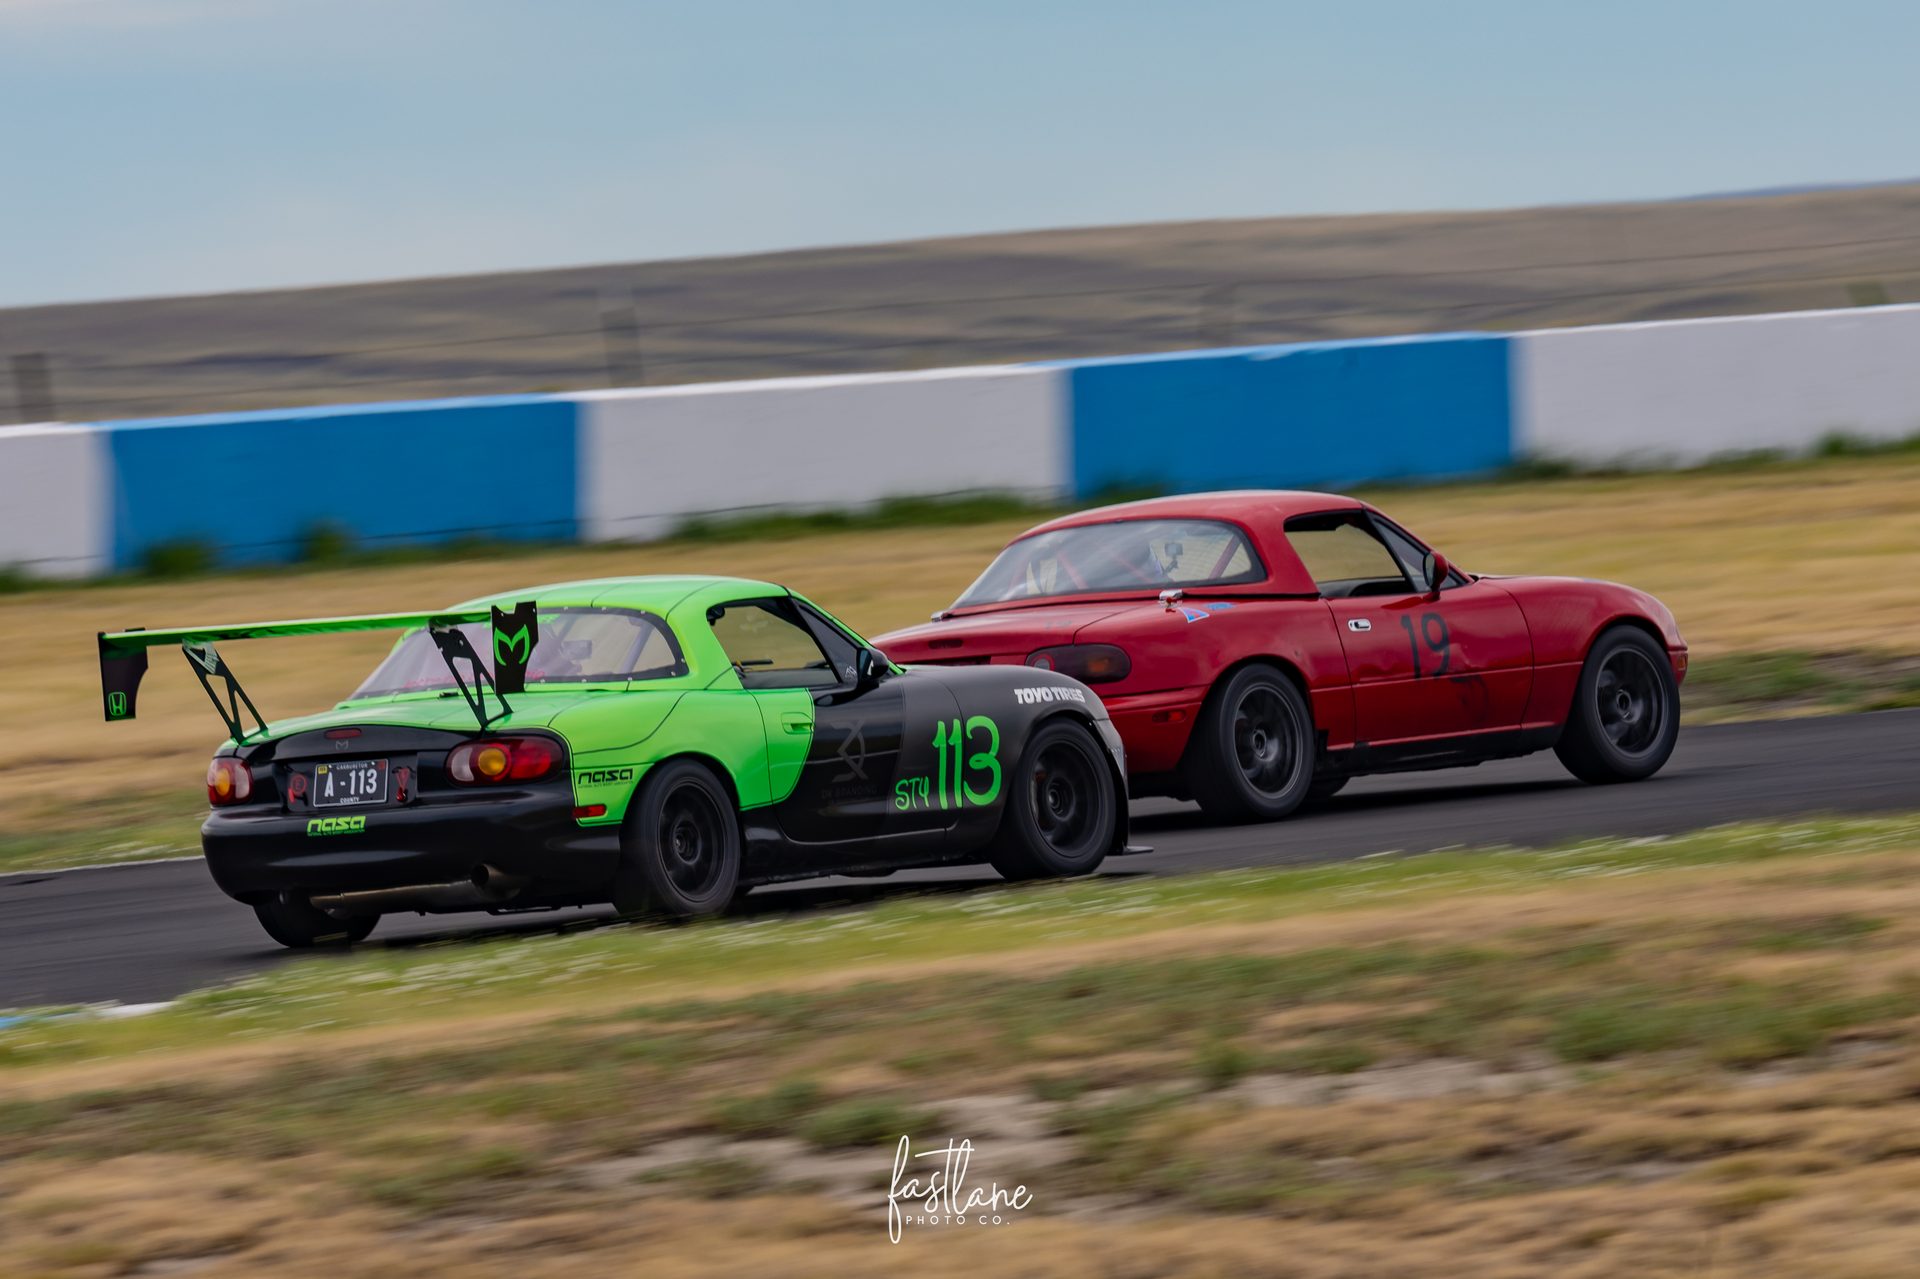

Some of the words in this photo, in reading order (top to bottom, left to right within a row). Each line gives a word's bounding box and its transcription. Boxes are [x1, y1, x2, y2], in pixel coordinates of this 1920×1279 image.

[1401, 612, 1450, 680] 19
[1013, 687, 1053, 704] TOYO
[1051, 687, 1085, 703] TIRES
[932, 715, 1001, 809] 113
[578, 768, 633, 784] nasa
[307, 816, 366, 832] nasa
